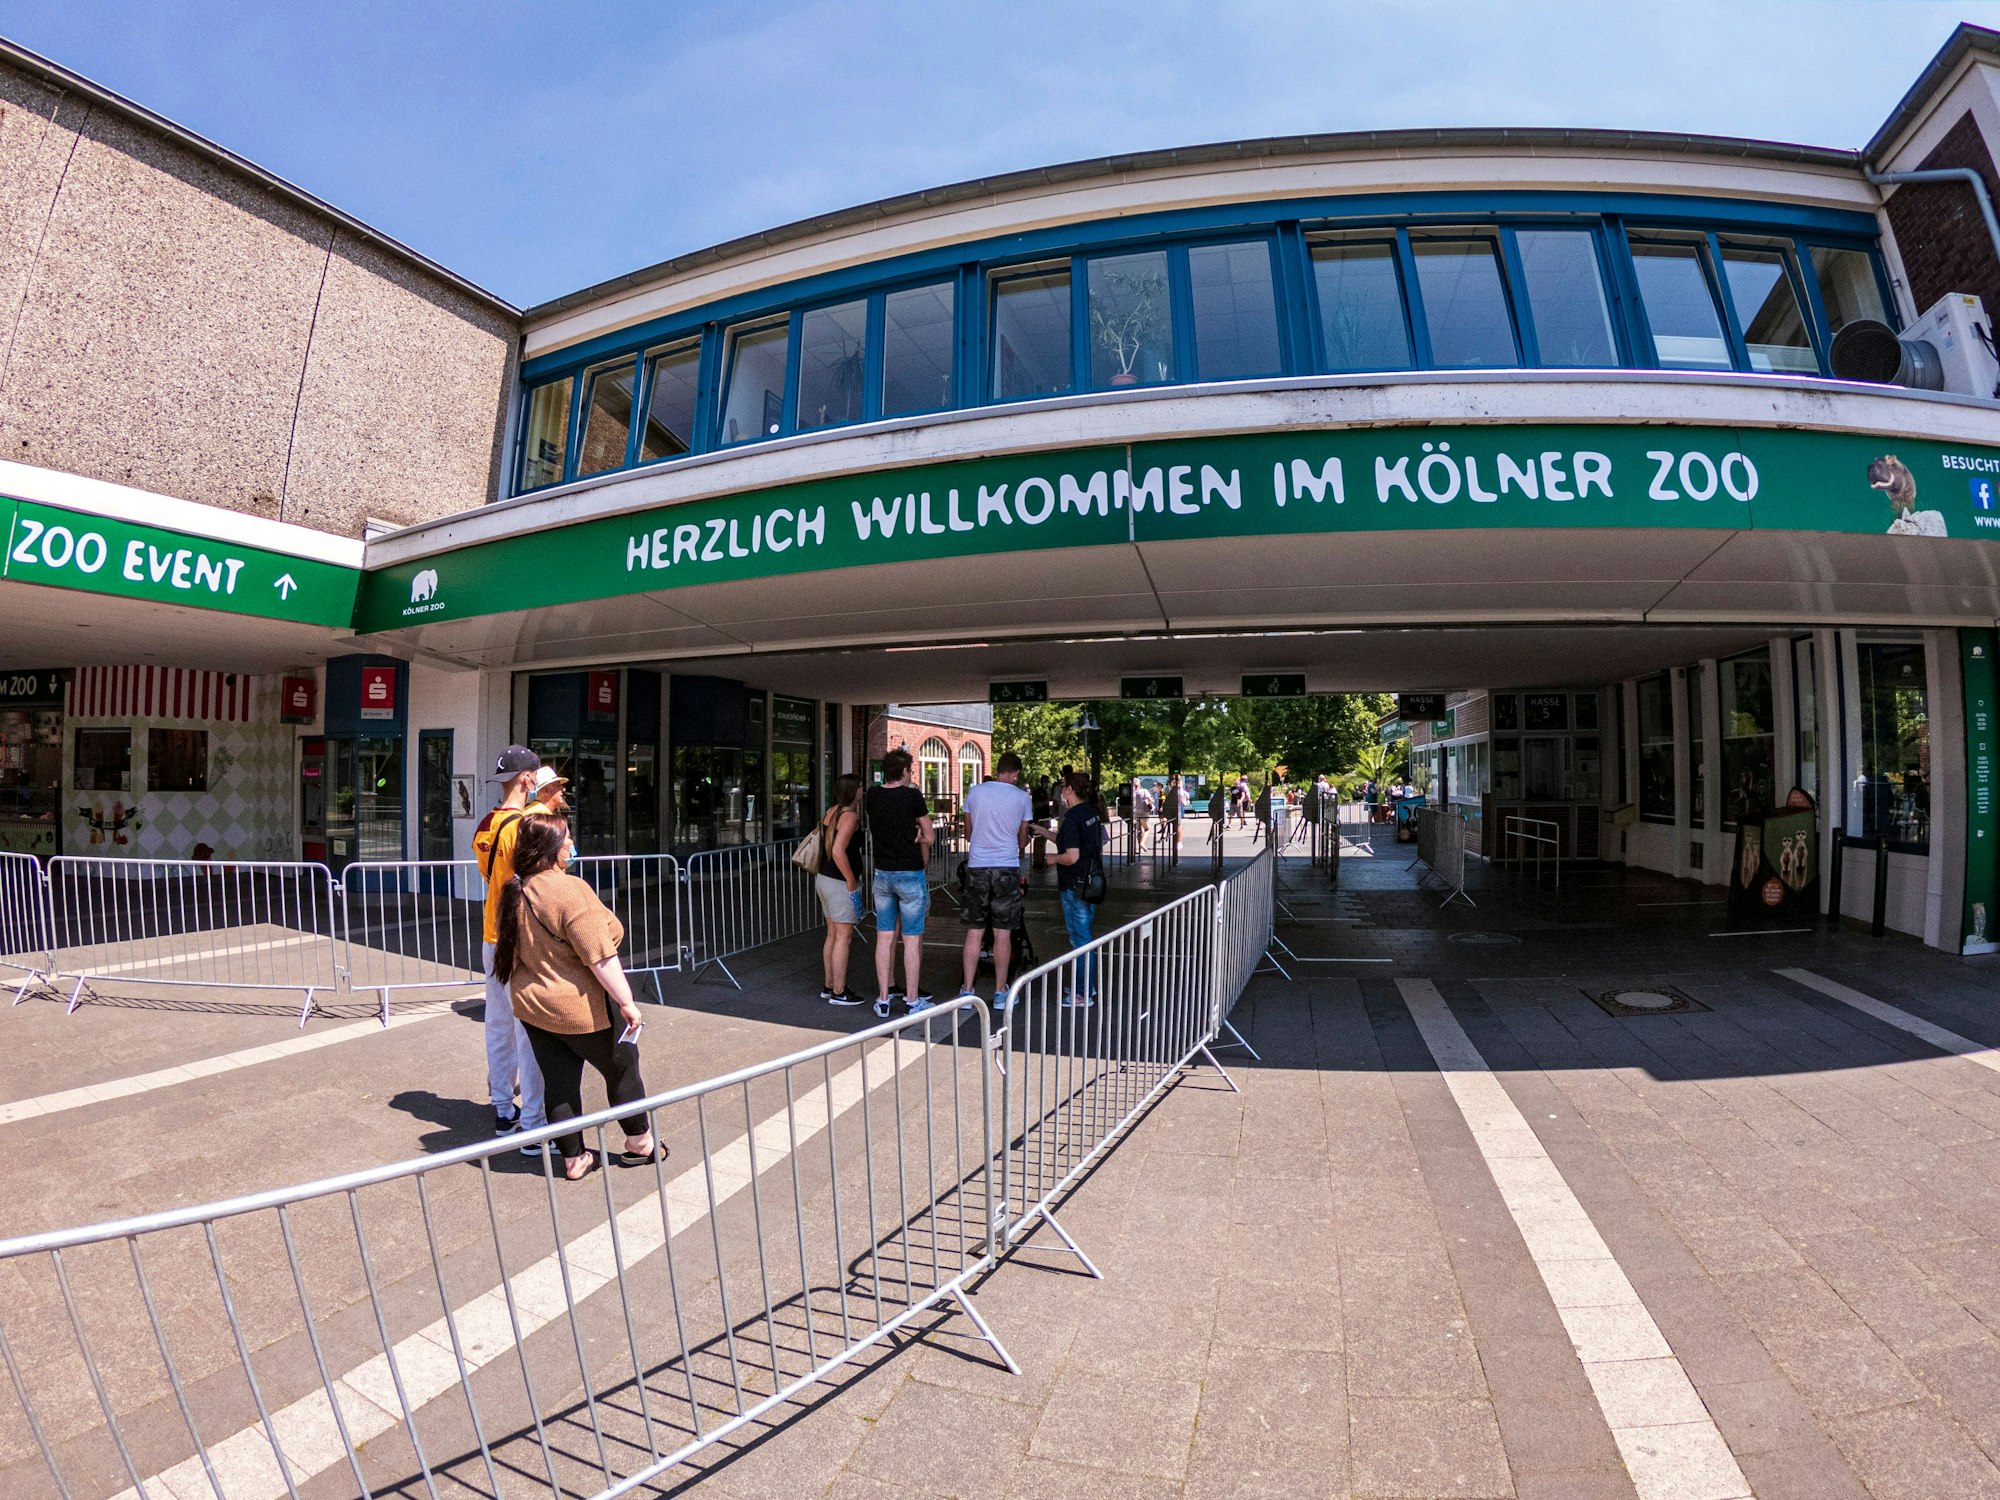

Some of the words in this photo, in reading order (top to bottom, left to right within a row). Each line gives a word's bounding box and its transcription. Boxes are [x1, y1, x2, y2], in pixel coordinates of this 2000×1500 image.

[1942, 455, 2000, 473] BESUCHT
[626, 505, 825, 571] HERZLICH
[851, 463, 1242, 540] WILLKOMMEN
[1274, 457, 1345, 507] IM
[1375, 442, 1614, 504] KÖLNER
[1646, 451, 1759, 502] ZOO
[12, 519, 107, 573] ZOO
[122, 540, 245, 595] EVENT
[402, 605, 429, 616] KÖLNER
[430, 602, 445, 611] ZOO
[9, 674, 37, 696] ZOO
[1409, 695, 1435, 704] KASSE
[1530, 697, 1560, 706] KASSE
[1419, 703, 1426, 712] 6
[1541, 707, 1550, 719] 5
